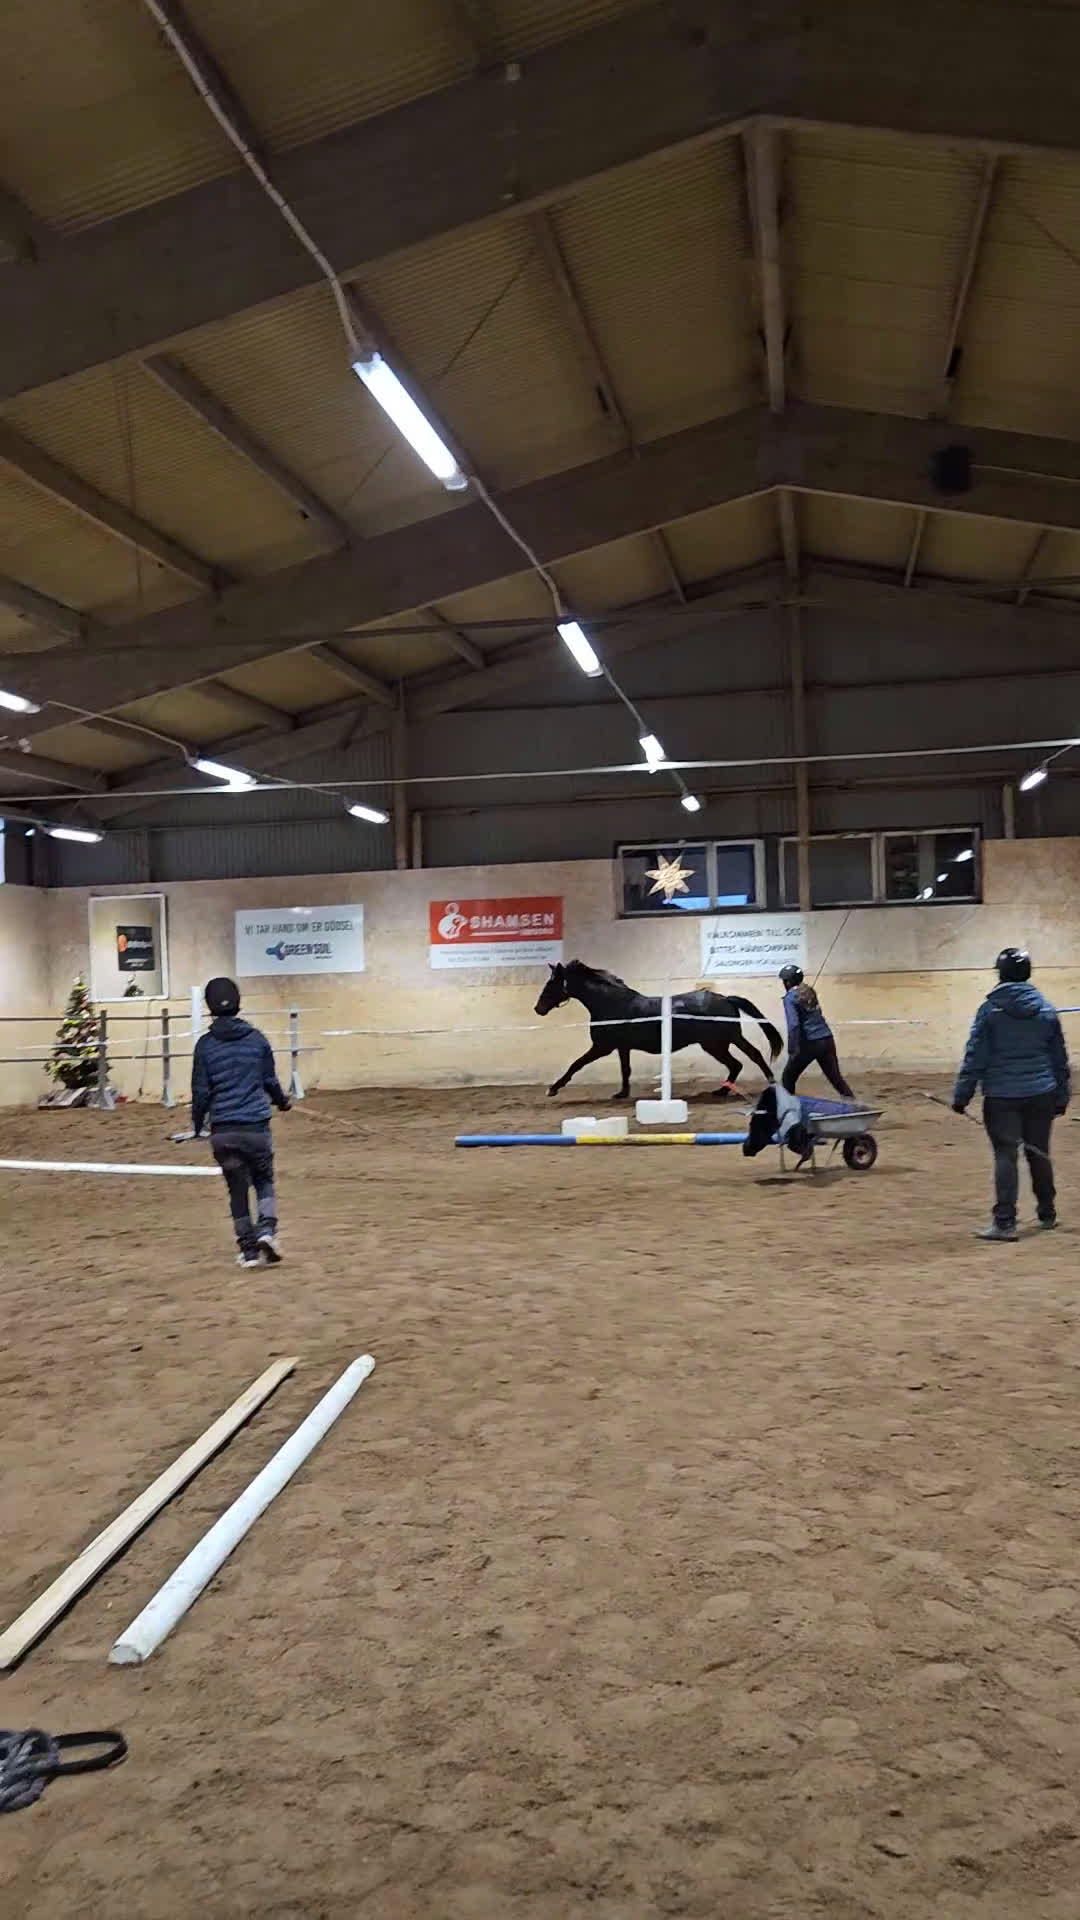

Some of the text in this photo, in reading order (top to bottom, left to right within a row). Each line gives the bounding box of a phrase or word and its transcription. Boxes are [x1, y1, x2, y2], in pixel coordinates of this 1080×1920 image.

[470, 913, 554, 928] SHAMSEN
[245, 925, 253, 935] VI
[256, 924, 270, 935] TAR
[272, 923, 293, 934] HAND
[312, 921, 322, 932] ER
